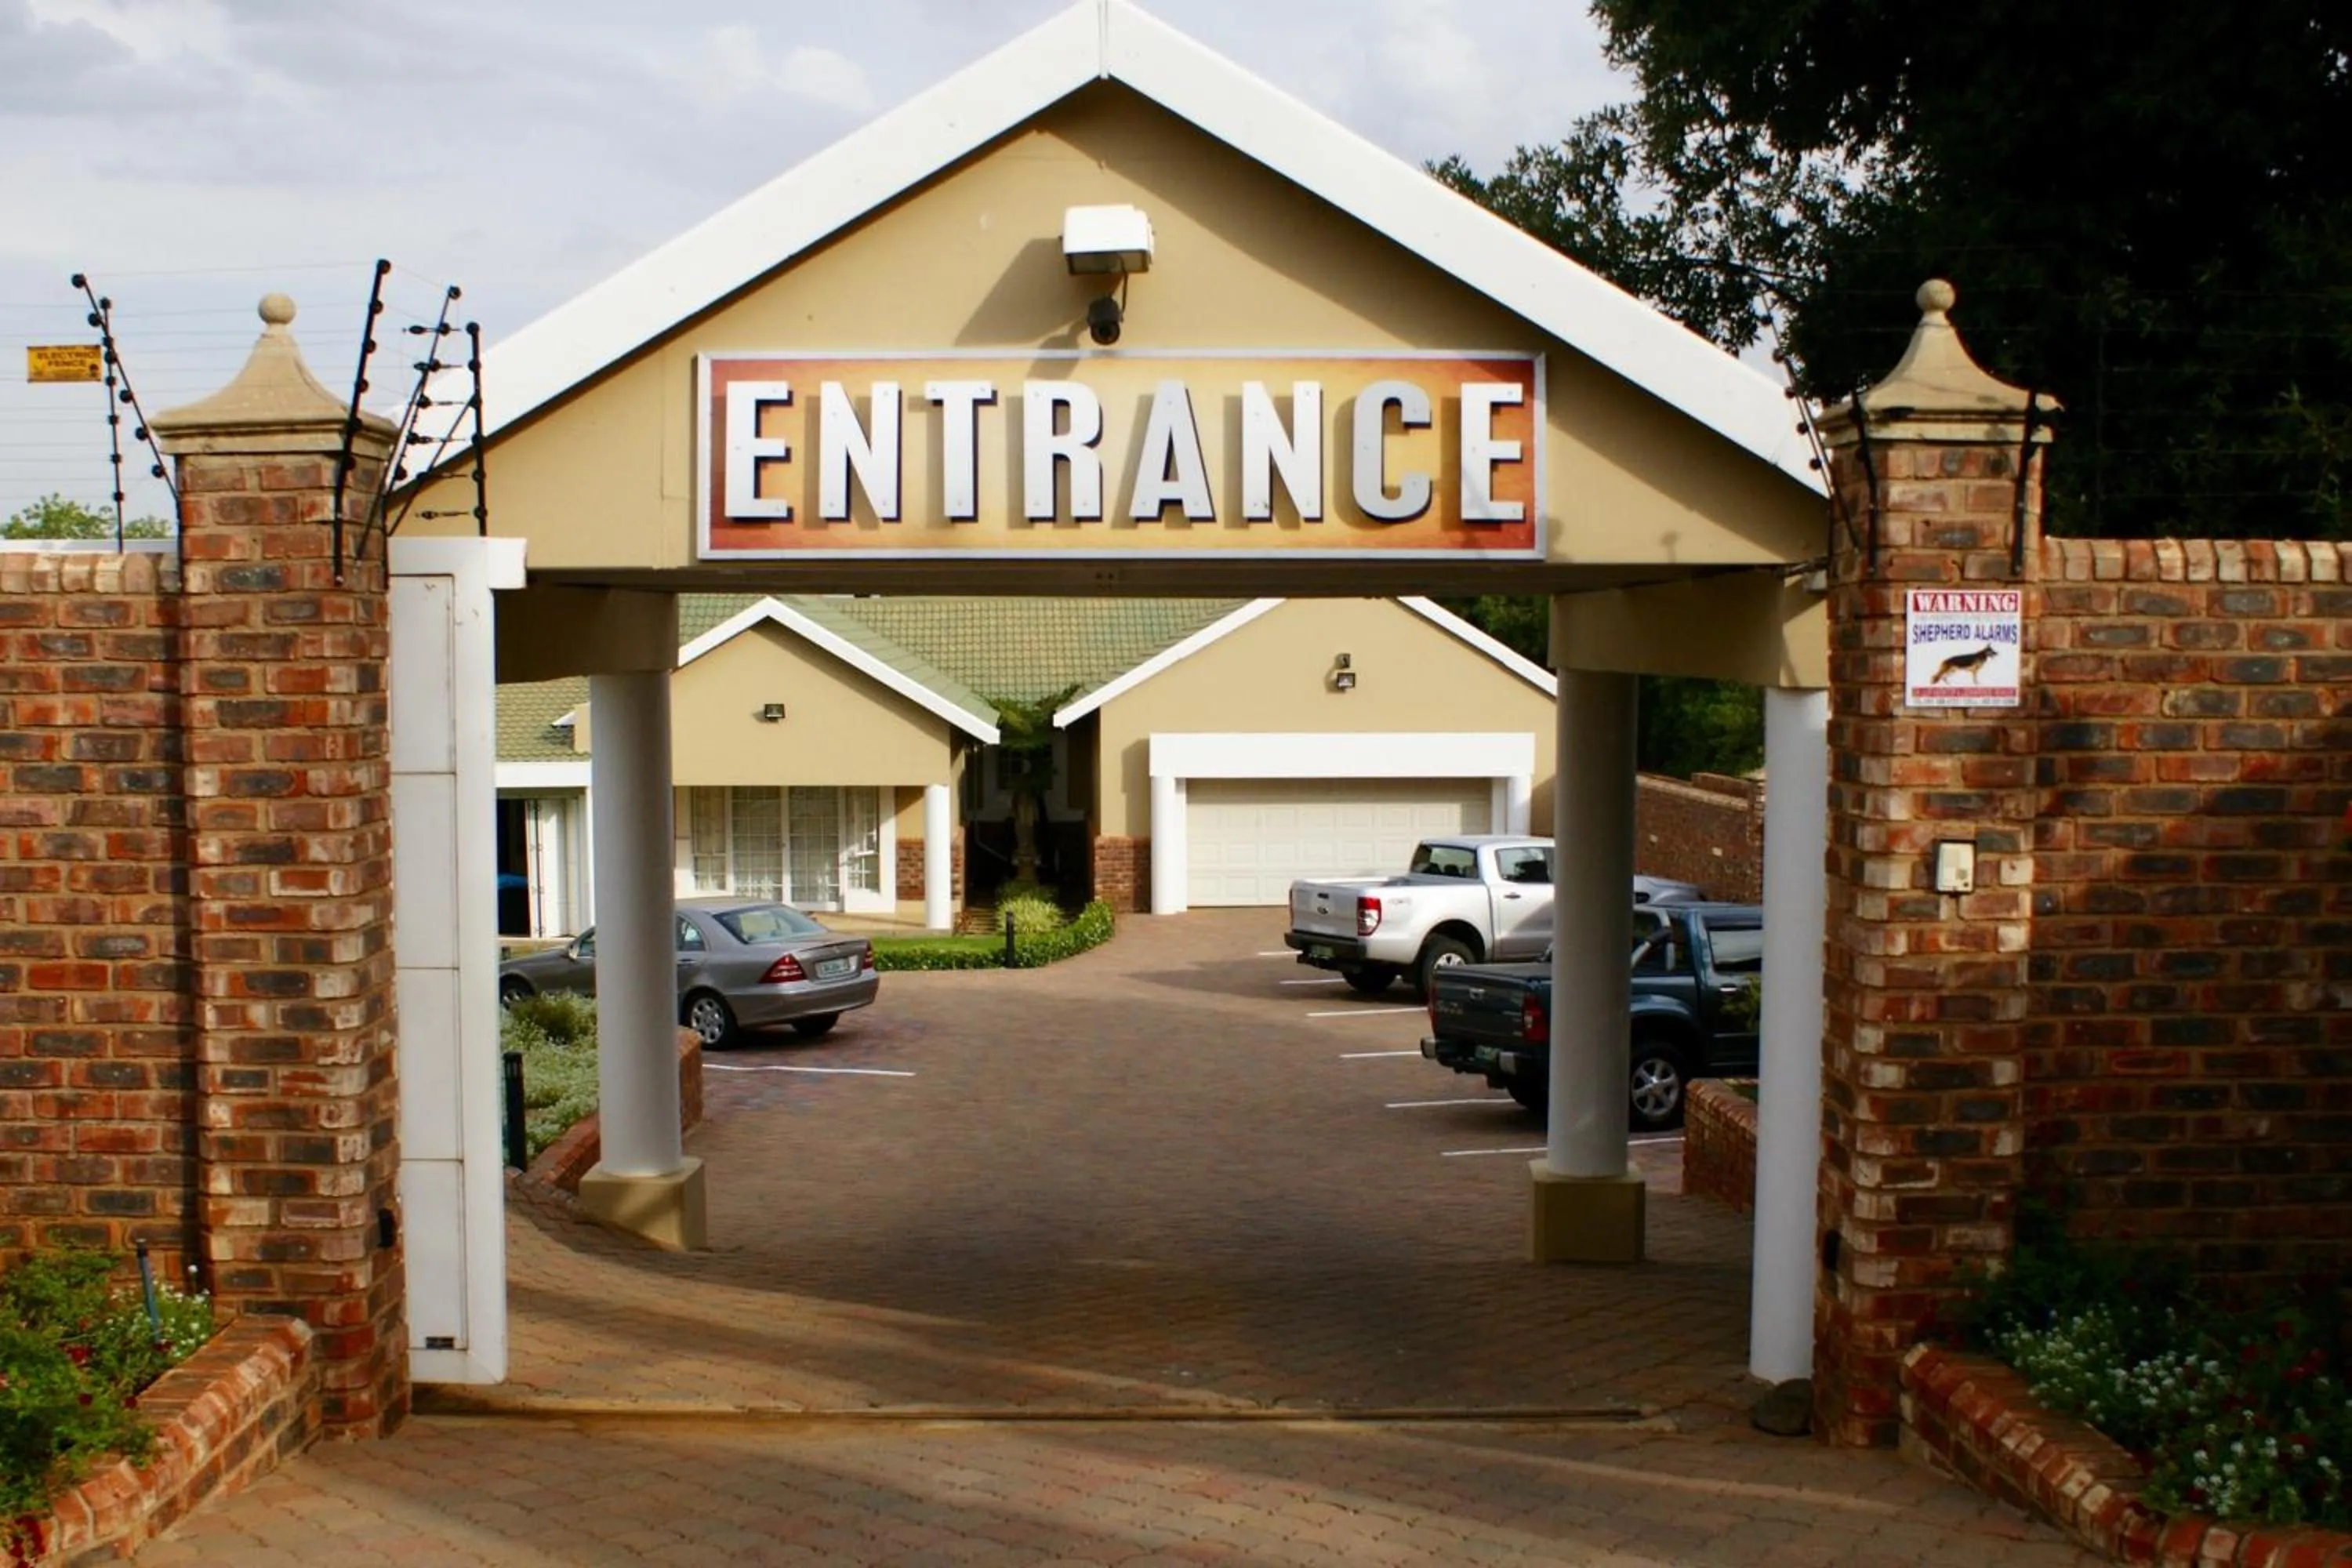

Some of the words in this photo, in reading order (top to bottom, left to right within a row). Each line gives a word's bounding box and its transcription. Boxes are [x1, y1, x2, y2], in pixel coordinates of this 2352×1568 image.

[724, 379, 1526, 521] ENTRANCE
[1915, 593, 2016, 612] WARNING
[1913, 624, 1970, 644] SHEPHERD
[1974, 624, 2017, 644] ALARMS
